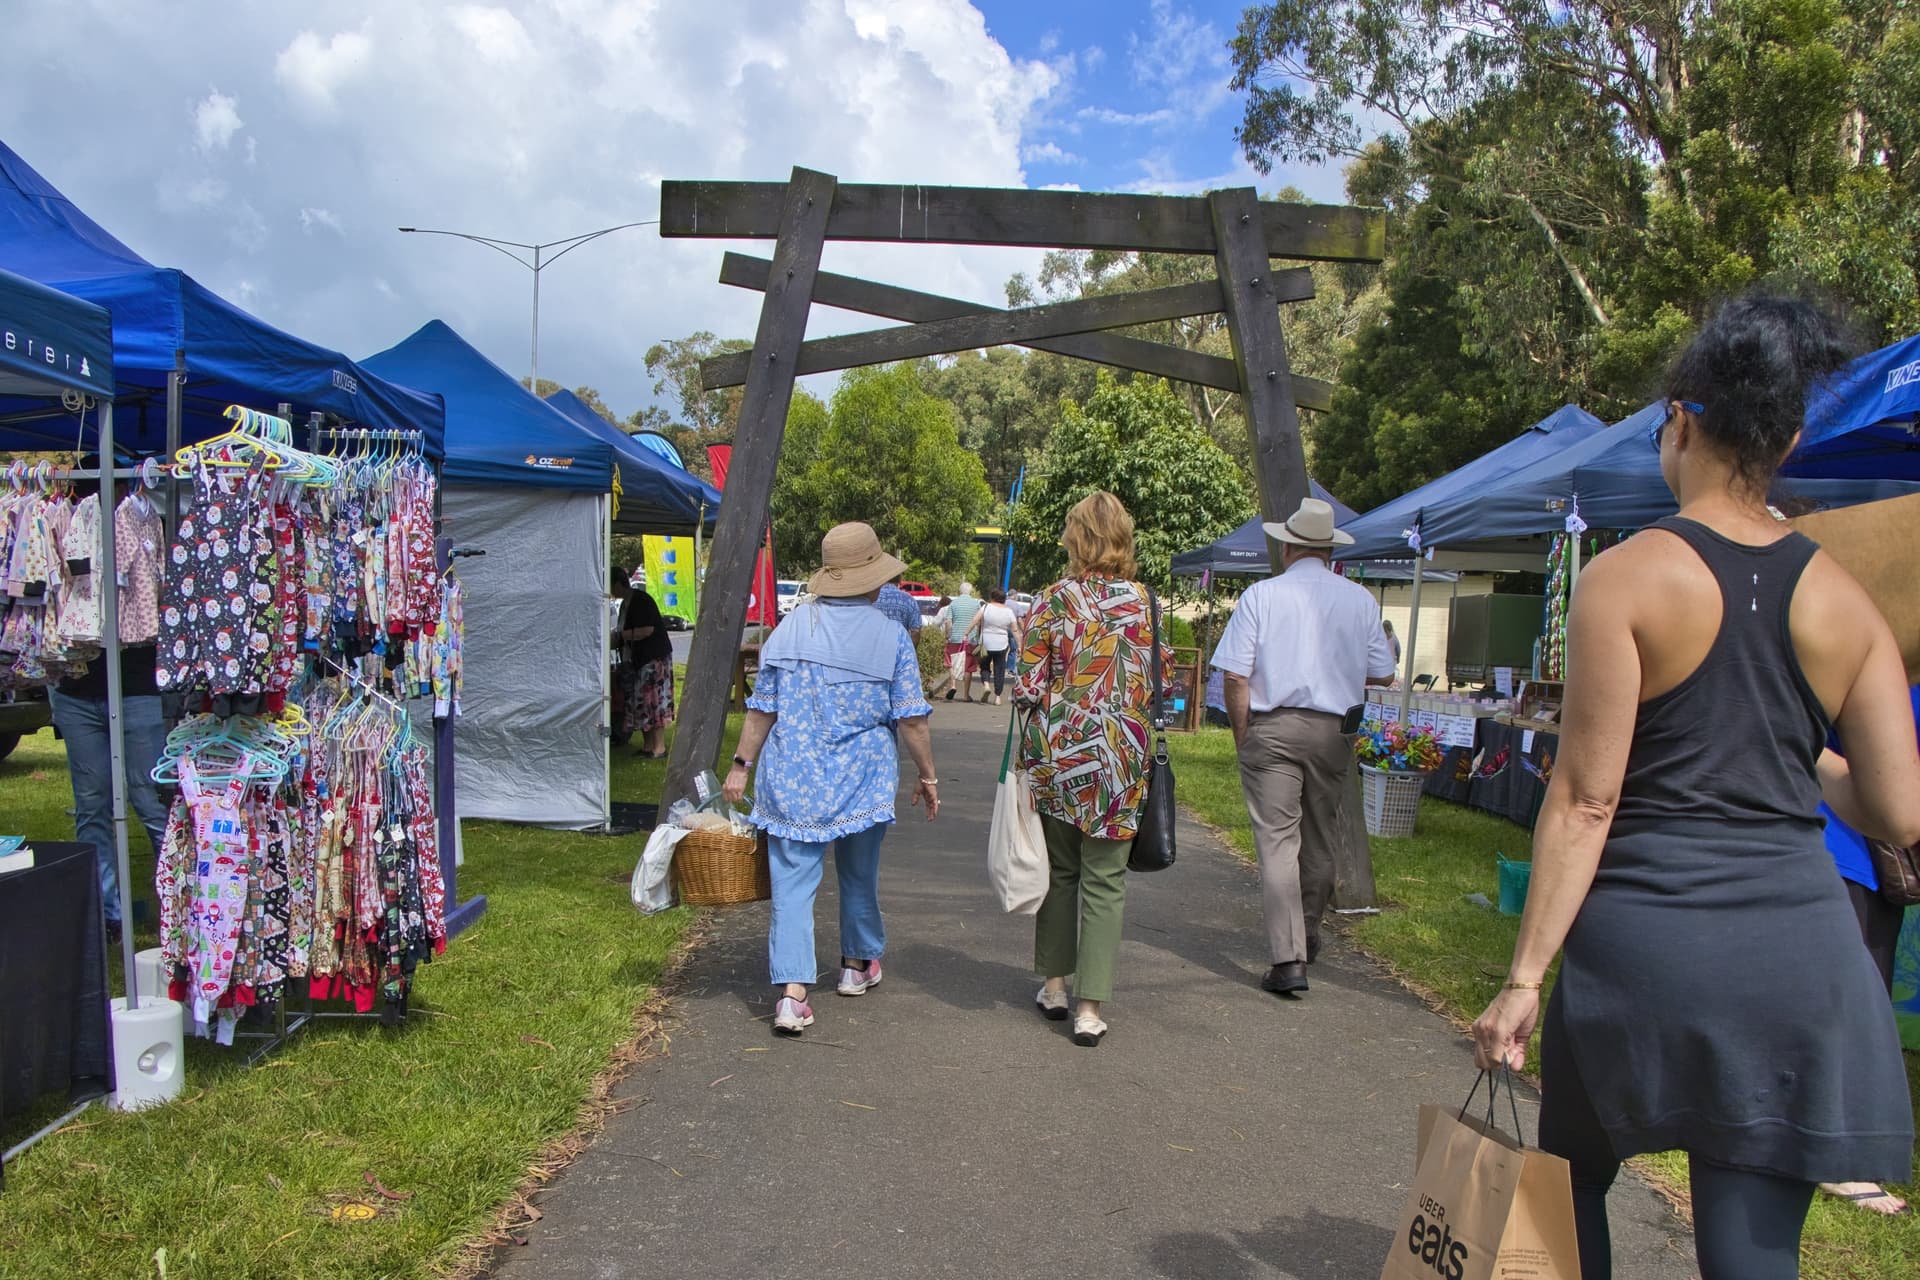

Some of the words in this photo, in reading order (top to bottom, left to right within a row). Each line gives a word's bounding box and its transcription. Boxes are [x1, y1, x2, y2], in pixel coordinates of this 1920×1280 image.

[332, 369, 358, 395] KINGS
[1419, 1192, 1445, 1223] UBER
[1409, 1214, 1468, 1280] eats
